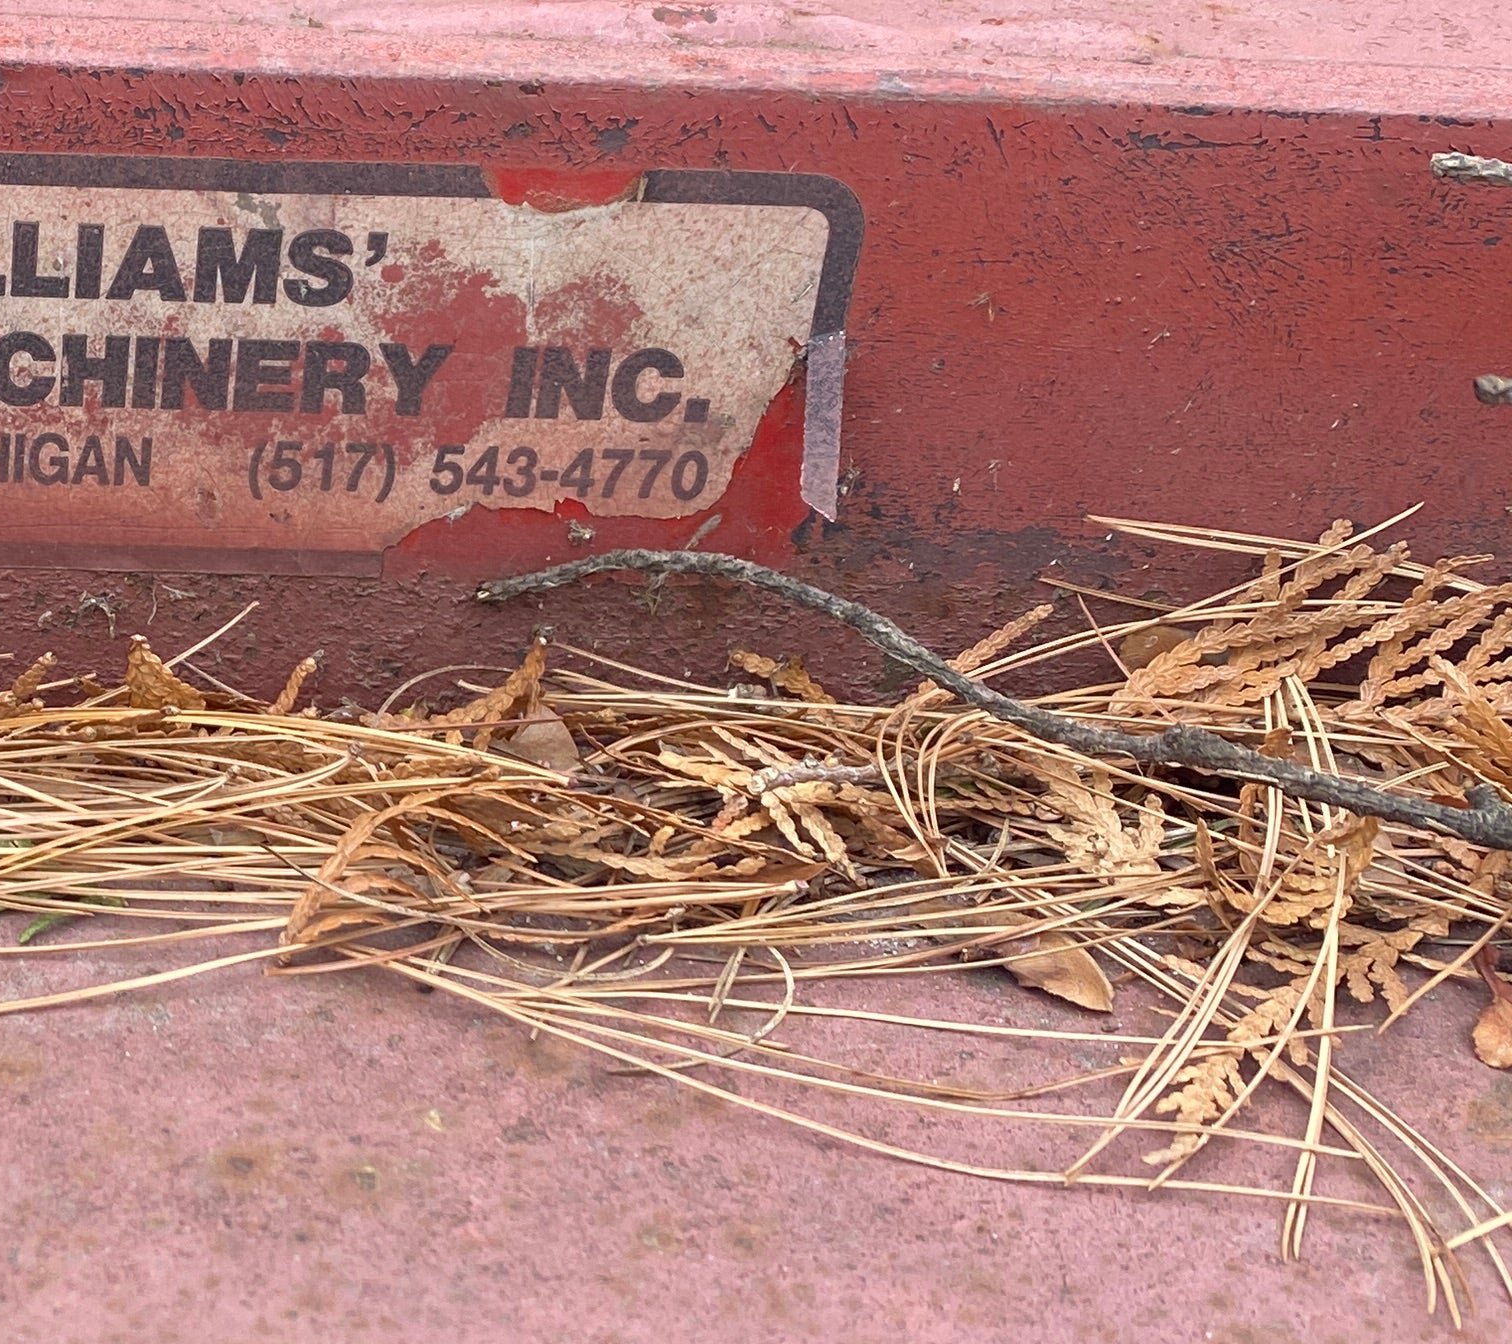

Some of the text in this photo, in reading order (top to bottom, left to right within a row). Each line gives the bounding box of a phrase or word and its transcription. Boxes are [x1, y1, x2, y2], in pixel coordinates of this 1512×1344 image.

[503, 346, 711, 423] INC.
[248, 439, 397, 503] (517)
[428, 444, 709, 501] 543-4770
